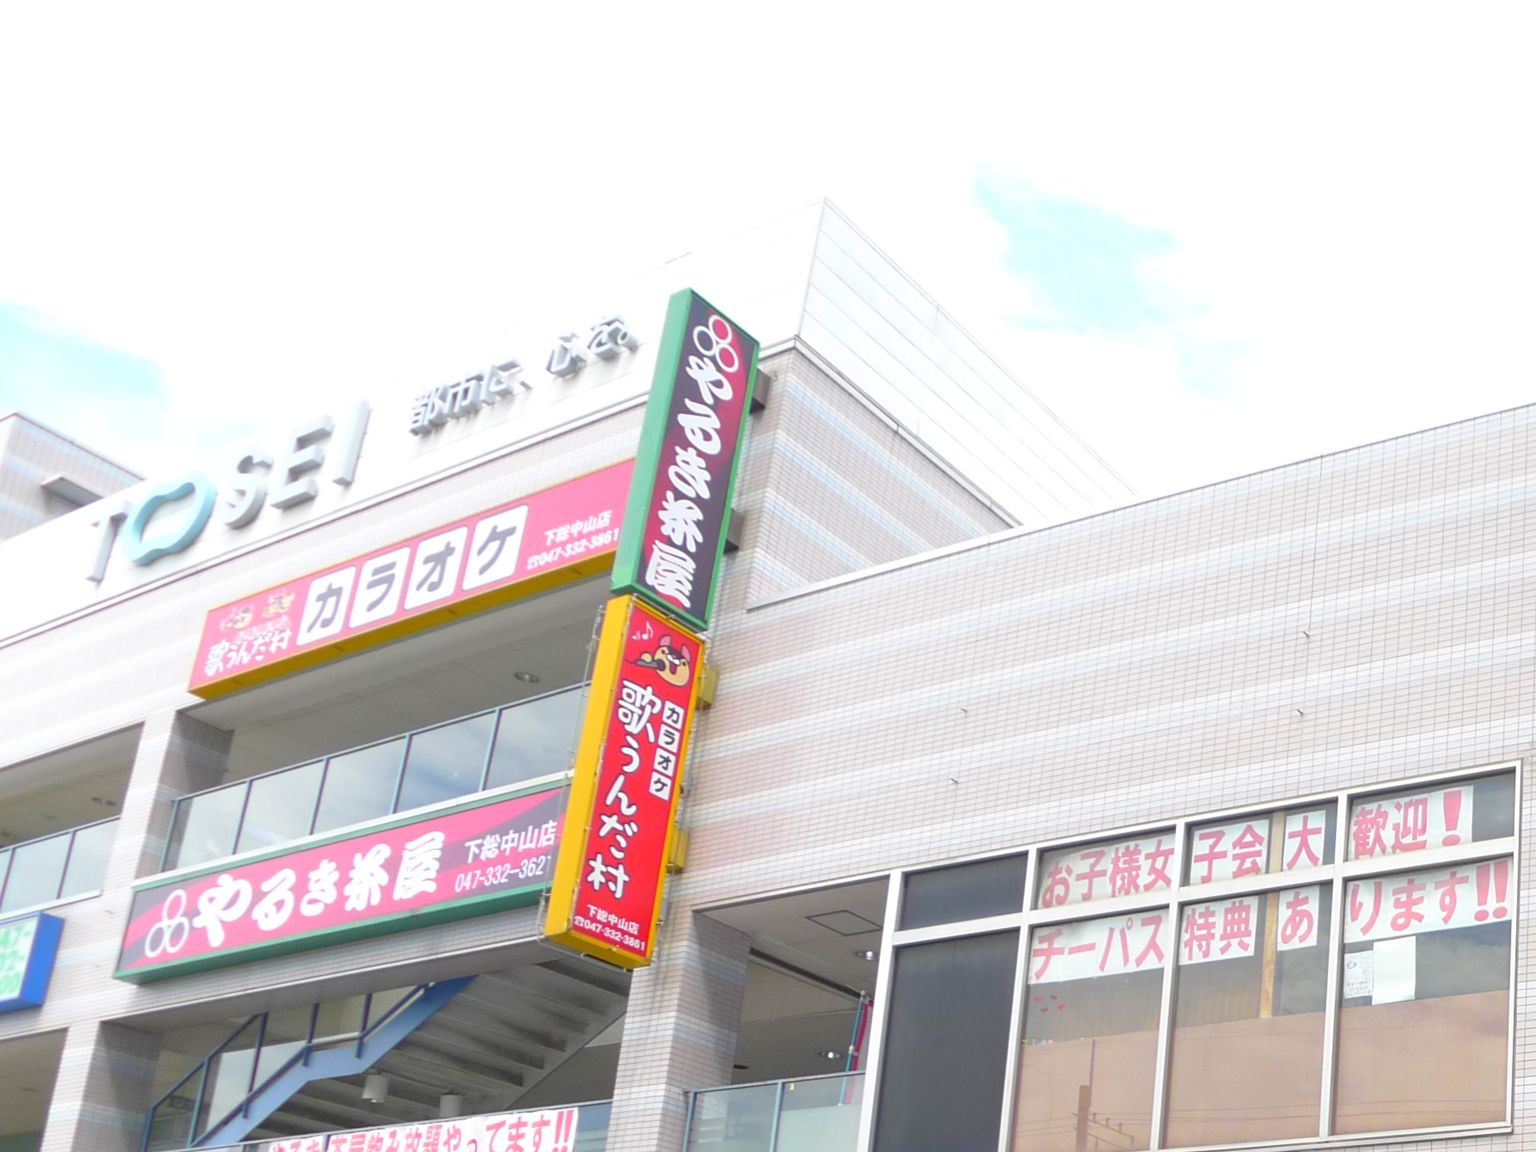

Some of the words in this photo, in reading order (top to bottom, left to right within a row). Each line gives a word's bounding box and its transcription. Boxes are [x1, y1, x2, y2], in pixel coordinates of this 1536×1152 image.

[85, 399, 372, 584] TOSEI
[544, 509, 612, 547] 下総中山店
[645, 354, 733, 609] やるき茶屋
[306, 524, 518, 633] カラオケ
[586, 680, 662, 900] 歌うんだ村
[652, 702, 683, 797] カラオケ
[194, 831, 446, 948] やるき茶屋
[465, 820, 557, 864] 下総中山店
